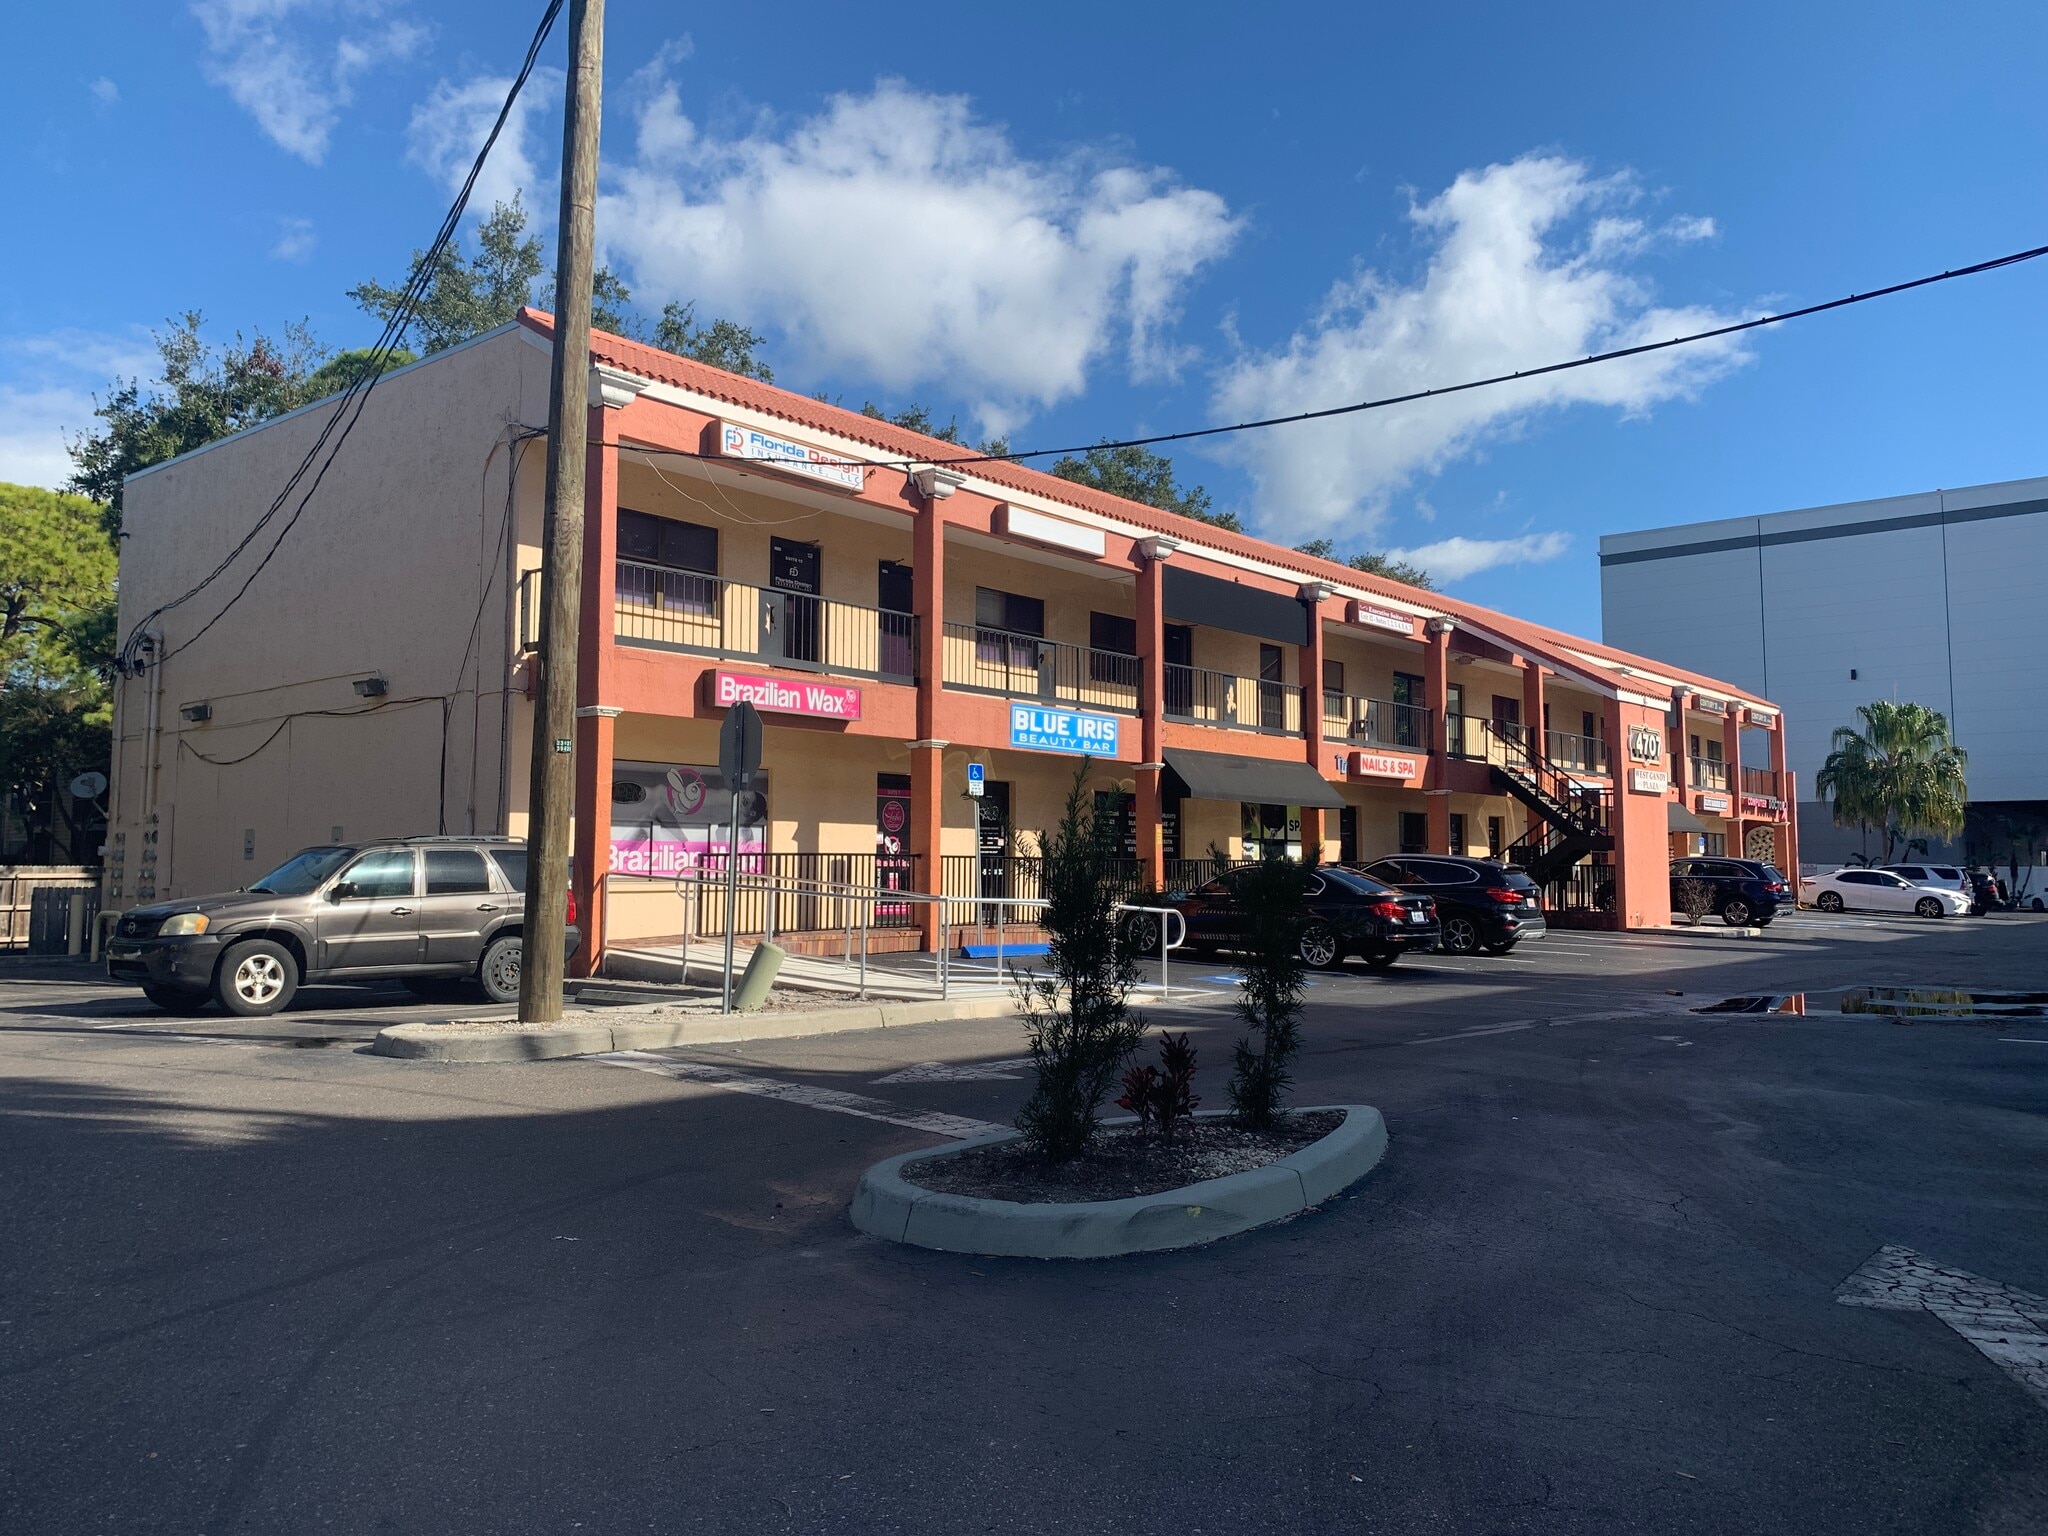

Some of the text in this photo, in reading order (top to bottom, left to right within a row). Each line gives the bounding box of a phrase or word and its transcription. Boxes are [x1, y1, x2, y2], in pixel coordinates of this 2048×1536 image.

[750, 432, 860, 474] Florida Design
[840, 472, 860, 485] LLC
[721, 676, 801, 709] Brazilian
[806, 686, 845, 714] Wax
[1015, 709, 1115, 741] BLUE IRIS
[1019, 732, 1110, 751] BEAUTY BAR
[1636, 732, 1661, 757] 4707
[1362, 757, 1388, 773] NAILS
[1390, 760, 1395, 773] &
[1397, 761, 1414, 775] SPA
[1636, 770, 1648, 779] WEST
[1643, 781, 1660, 790] PLAZA
[1747, 797, 1767, 809] COMPUTER
[1289, 819, 1301, 832] SP
[608, 844, 702, 872] Brazilian
